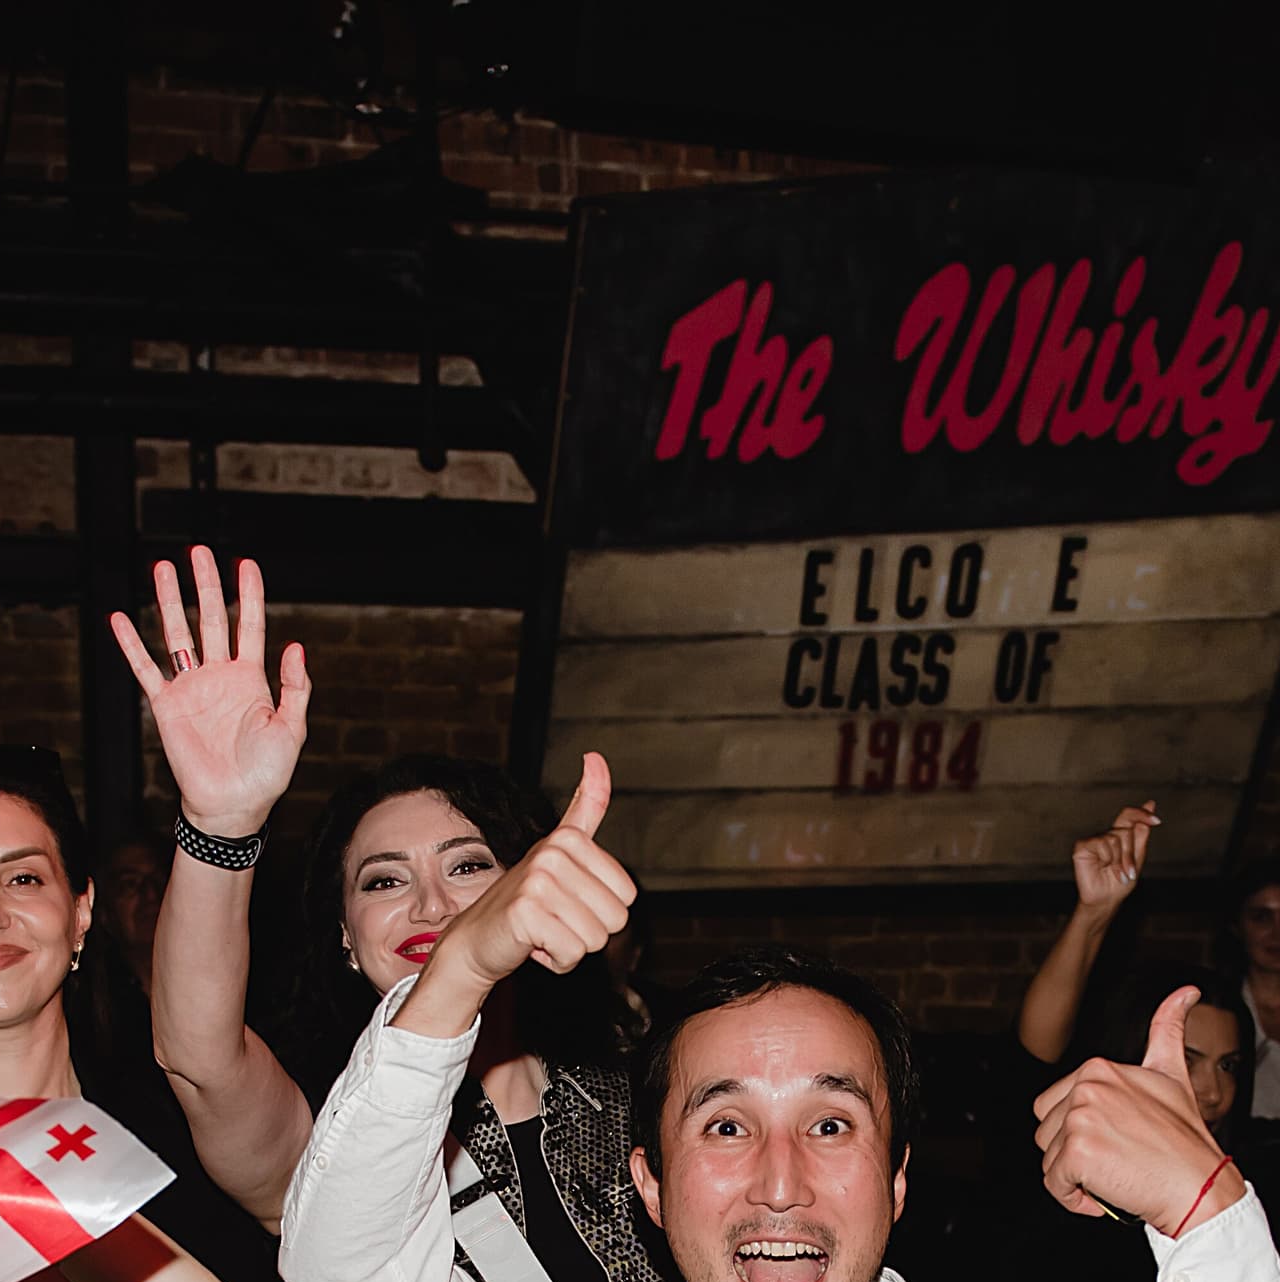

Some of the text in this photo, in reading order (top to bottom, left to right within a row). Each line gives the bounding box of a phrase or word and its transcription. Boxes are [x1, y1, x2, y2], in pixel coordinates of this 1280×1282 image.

[655, 278, 833, 463] The
[800, 536, 1088, 626] ELCO E
[783, 631, 1060, 711] CLASS OF
[835, 719, 983, 796] 1984
